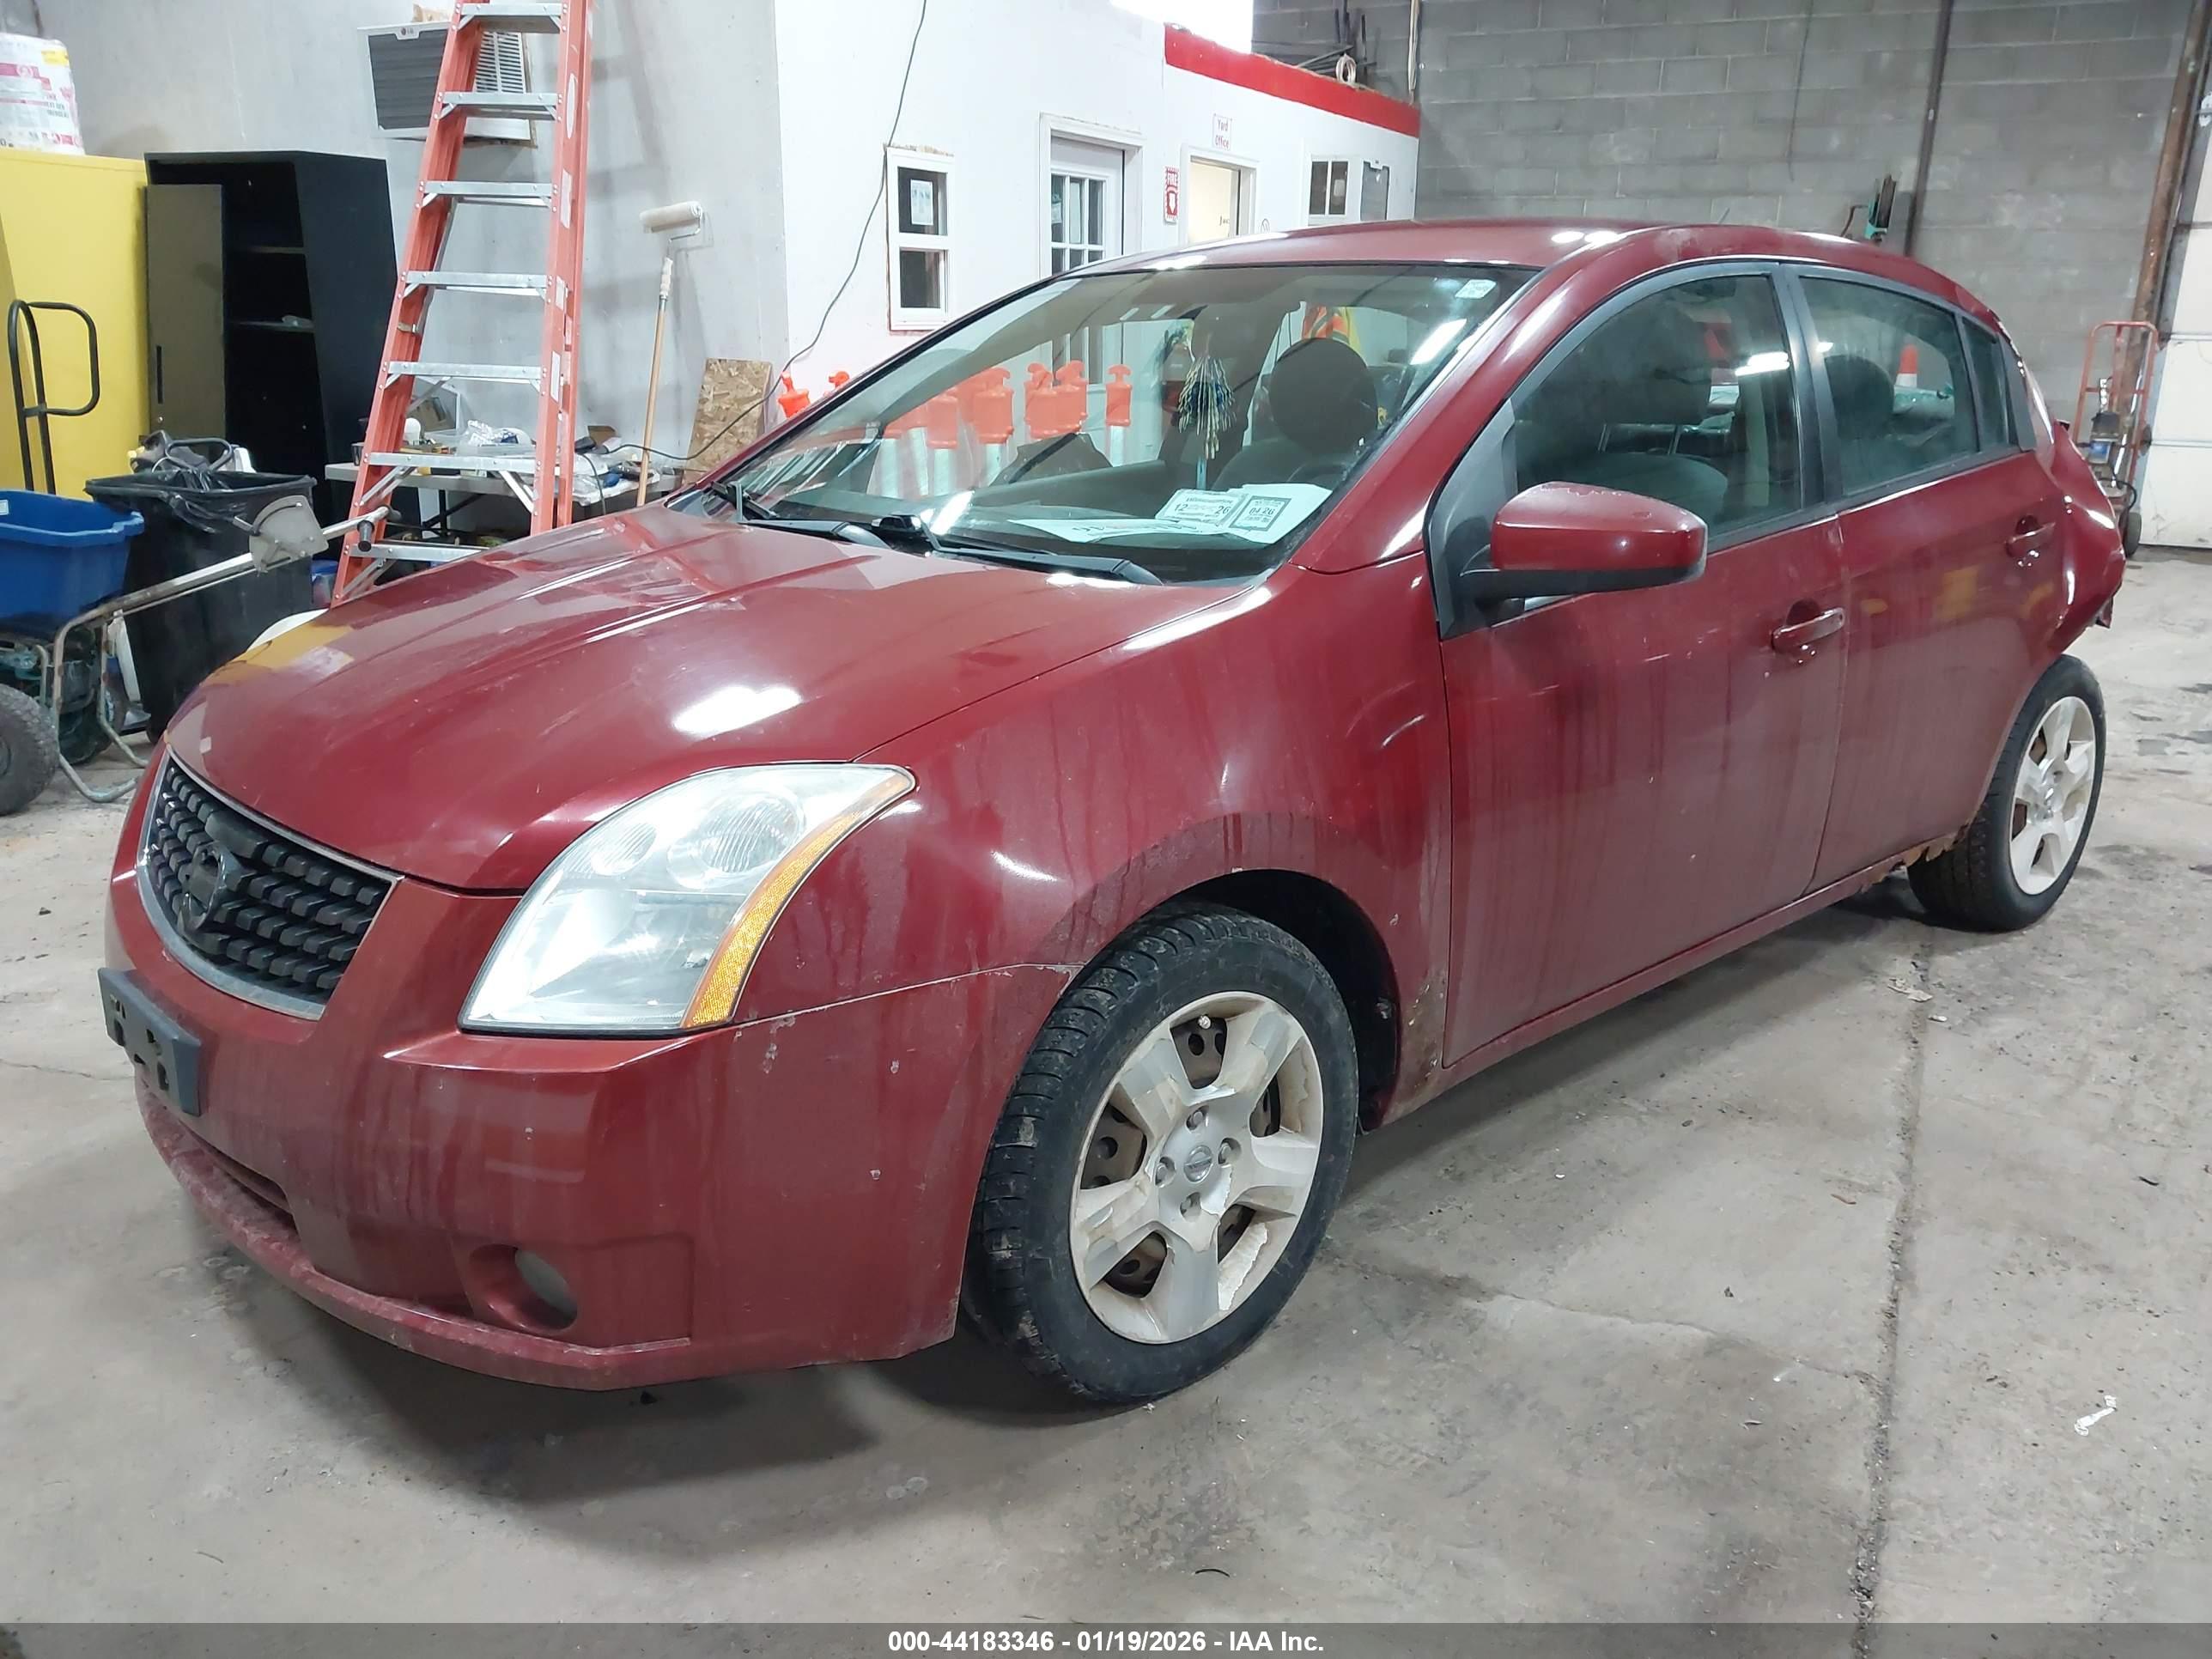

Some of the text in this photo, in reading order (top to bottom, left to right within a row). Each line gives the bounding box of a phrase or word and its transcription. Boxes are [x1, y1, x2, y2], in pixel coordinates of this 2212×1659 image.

[1217, 118, 1229, 131] Yard
[1215, 135, 1229, 149] Office
[1167, 173, 1177, 185] FIRE
[1174, 503, 1231, 514] 12 26
